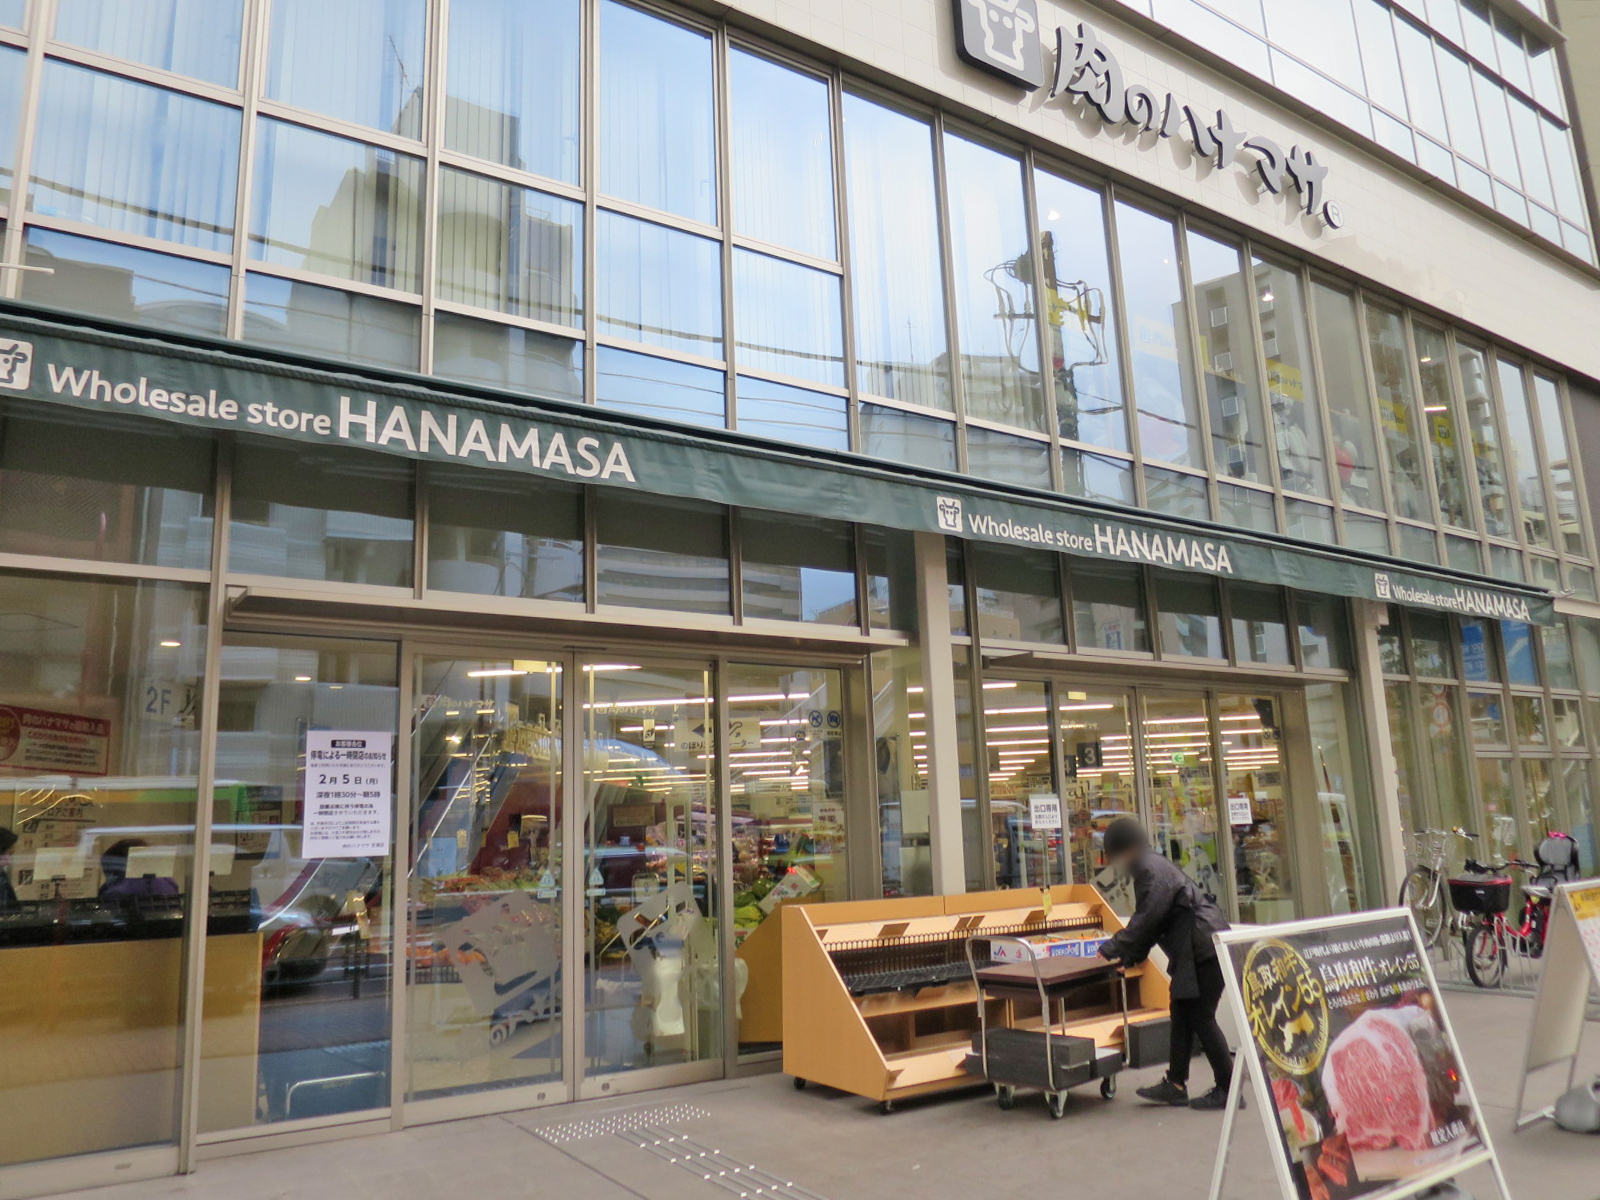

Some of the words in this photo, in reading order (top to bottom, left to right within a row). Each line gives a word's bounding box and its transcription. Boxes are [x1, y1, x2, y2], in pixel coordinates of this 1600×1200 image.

[1051, 22, 1328, 216] 肉のハナマサ
[48, 364, 239, 421] Wholesale
[247, 402, 331, 436] store
[337, 396, 637, 484] HANAMASA
[968, 514, 1054, 545] Wholesale
[1055, 529, 1093, 552] store
[1094, 523, 1234, 574] HANAMASA
[1392, 584, 1435, 607] Wholesale
[1435, 595, 1457, 611] store
[1455, 588, 1532, 622] HANAMASA
[1084, 747, 1096, 765] 3
[1318, 955, 1378, 994] 鳥取和牛
